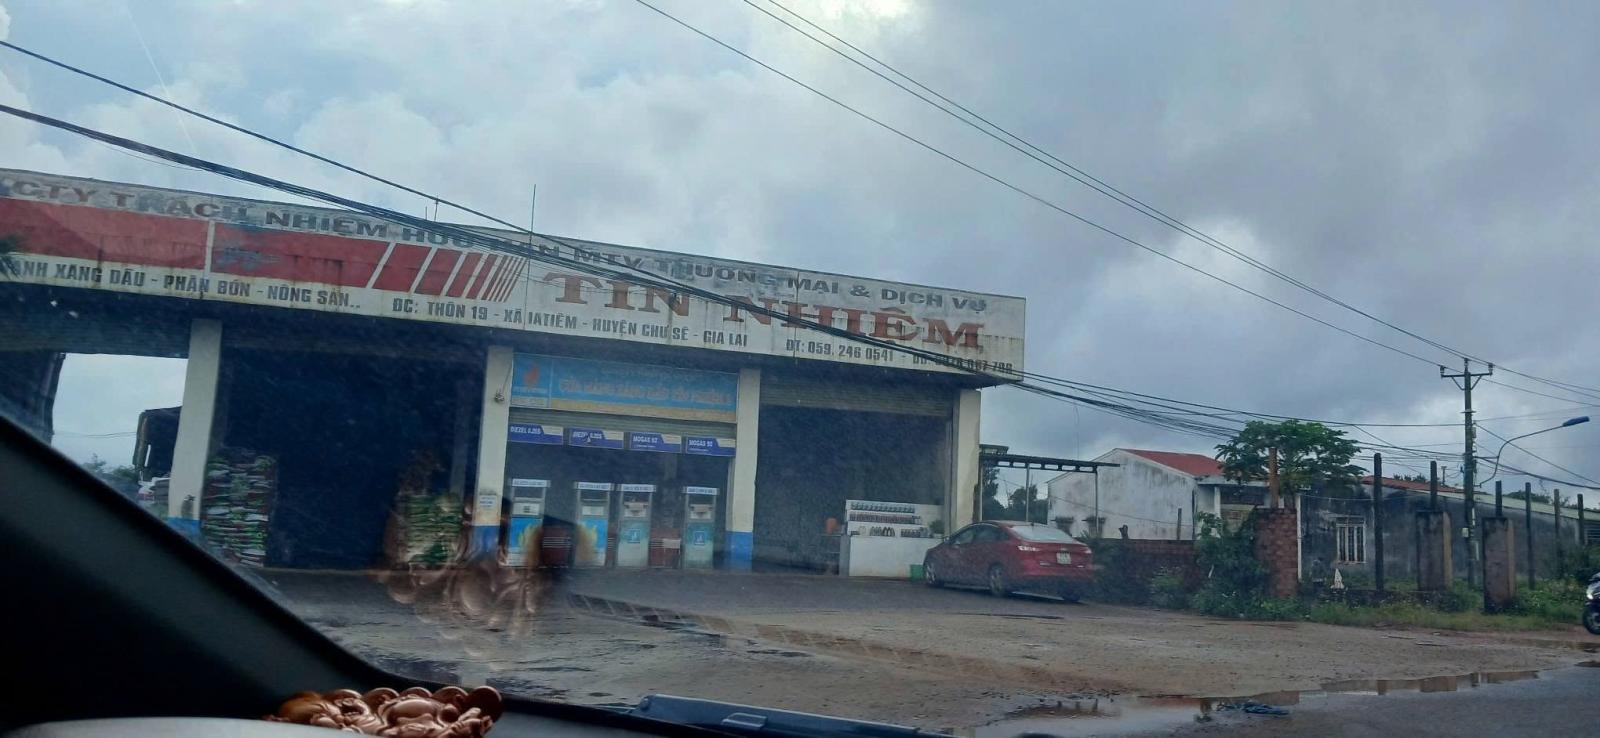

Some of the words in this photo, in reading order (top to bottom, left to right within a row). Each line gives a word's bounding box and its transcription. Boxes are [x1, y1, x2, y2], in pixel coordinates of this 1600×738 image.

[164, 275, 209, 293] PHÂN
[267, 283, 311, 302] NÔNG
[787, 277, 838, 296] MẠI
[850, 284, 870, 298] &
[427, 301, 466, 319] THÔN
[471, 306, 488, 320] 19
[592, 318, 637, 337] HUYỆN
[641, 323, 670, 339] CHƯ
[703, 330, 725, 345] GIA
[729, 332, 748, 347] LAI
[838, 345, 861, 359] 246
[865, 347, 893, 362] 0541
